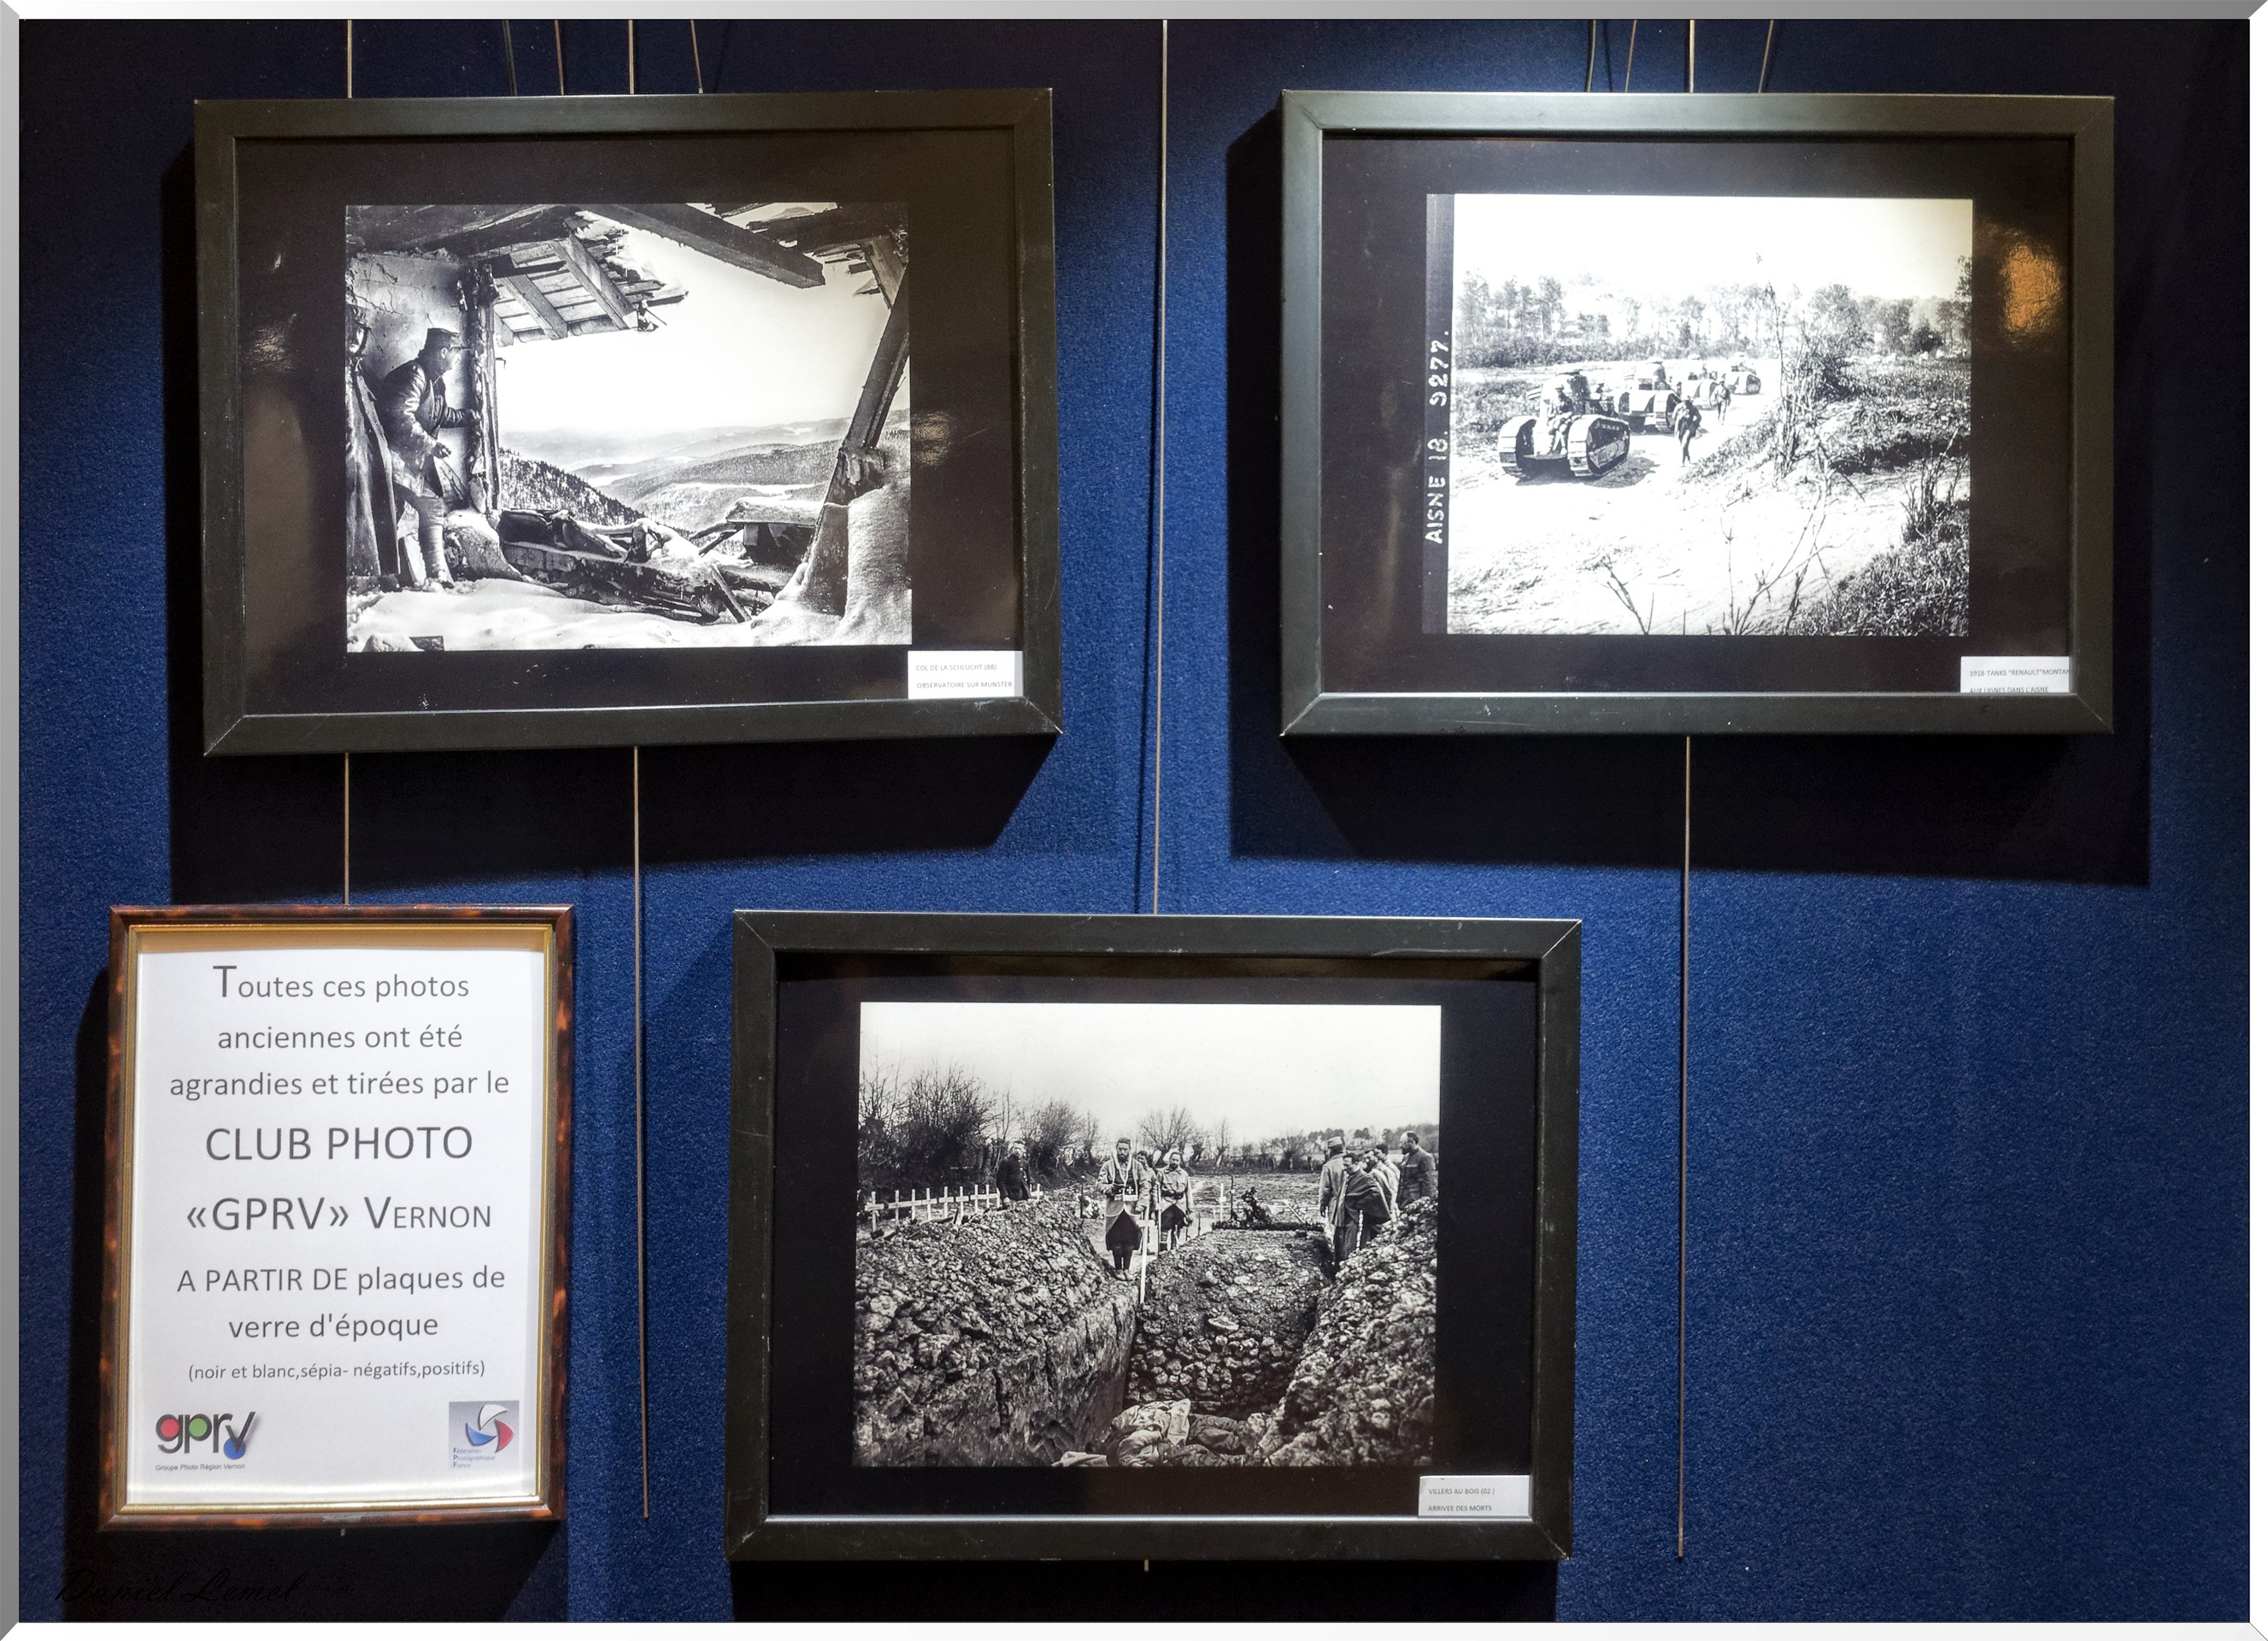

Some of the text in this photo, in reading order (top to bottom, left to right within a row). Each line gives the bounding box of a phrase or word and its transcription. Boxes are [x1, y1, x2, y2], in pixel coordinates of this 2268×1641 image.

[1425, 330, 1449, 544] AISNE 18. 9277.
[213, 966, 468, 1003] Toutes ces photos
[219, 1025, 461, 1049] anciennes ont été
[171, 1071, 508, 1101] agrandies et tirées par le
[207, 1126, 472, 1161] CLUB PHOTO
[187, 1197, 490, 1230] «GPRV» VERNON
[177, 1265, 504, 1295] A PARTIR DE plaques de
[229, 1314, 438, 1342] verre d'époque
[189, 1361, 485, 1381] (noir et blanc,sépia- négatifs,positifs)
[156, 1411, 256, 1454] gprv
